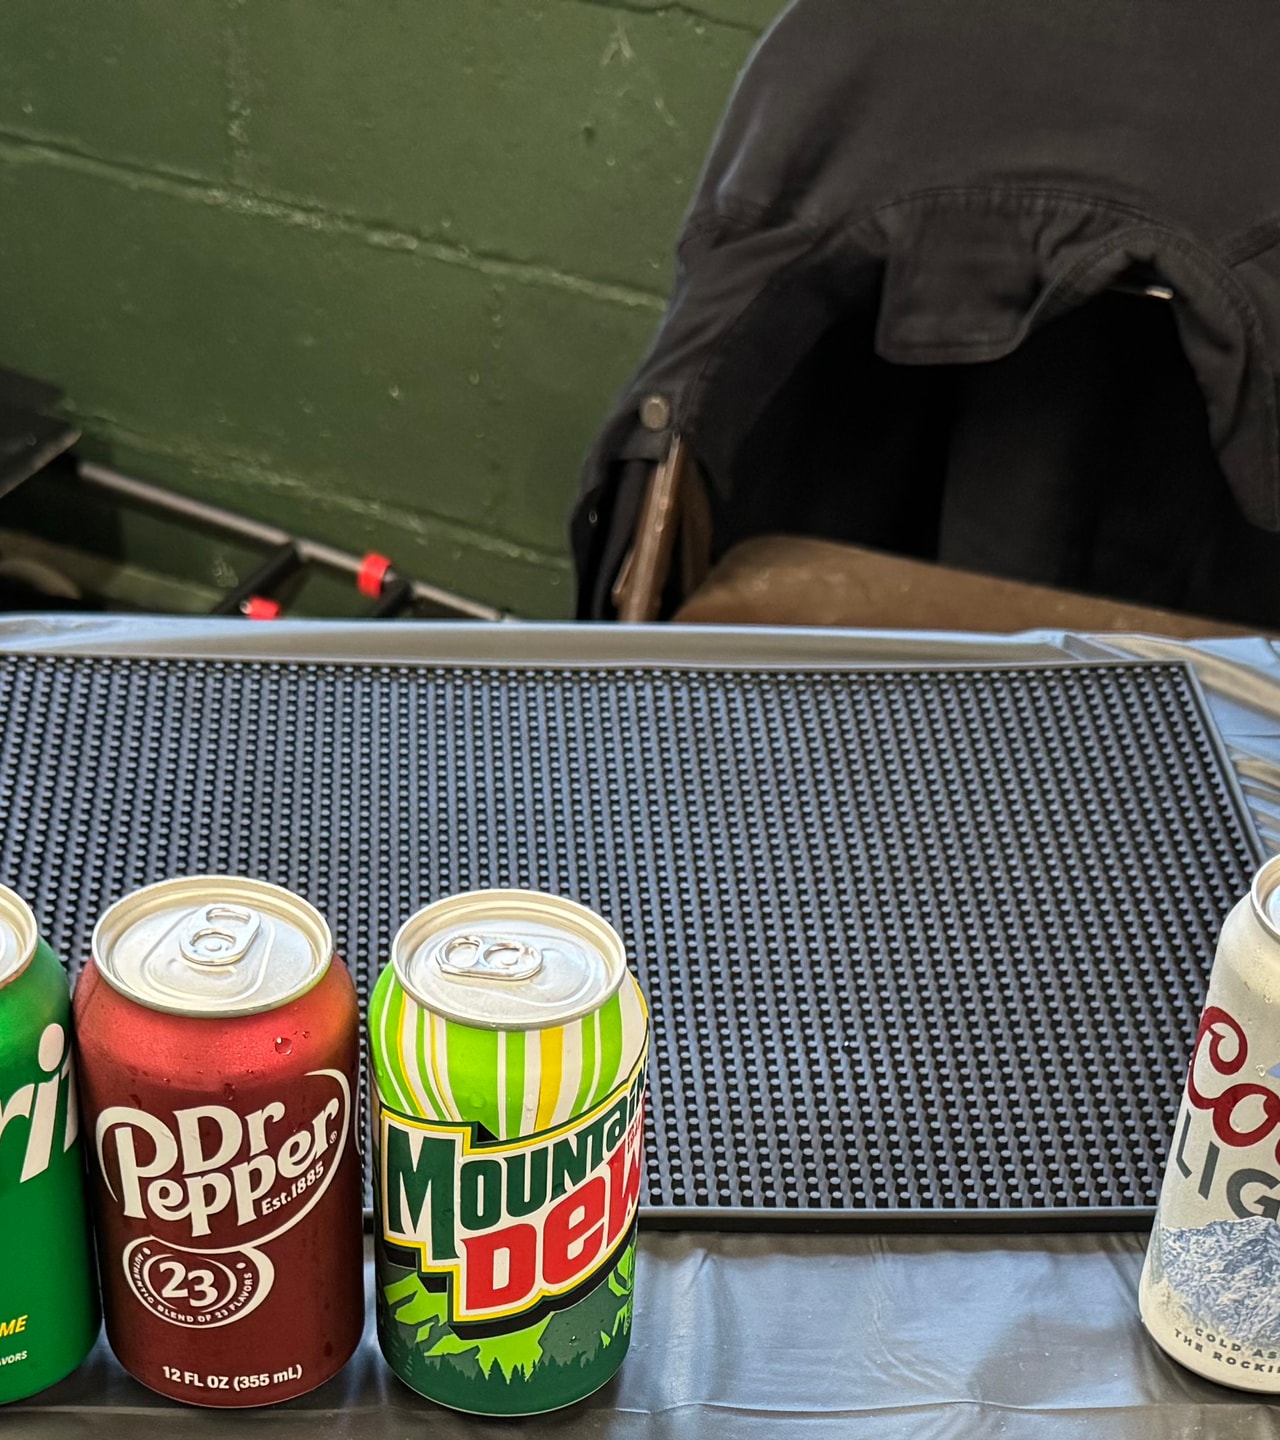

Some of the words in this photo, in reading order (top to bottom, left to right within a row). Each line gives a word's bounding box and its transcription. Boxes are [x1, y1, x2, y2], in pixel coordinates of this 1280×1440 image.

[173, 1101, 286, 1176] Dr
[95, 1098, 340, 1238] Pepper
[132, 1252, 155, 1305] AUTHENTIC
[156, 1304, 195, 1323] BLEND
[197, 1315, 212, 1323] OF
[228, 1272, 254, 1311] FLAVORS
[158, 1261, 219, 1308] 23
[1174, 1328, 1204, 1353] THE
[1194, 1327, 1242, 1352] COLD
[1252, 1348, 1278, 1360] AS
[162, 1365, 182, 1383] 12
[184, 1370, 205, 1387] FL
[206, 1375, 230, 1389] OZ
[233, 1373, 270, 1392] (355
[272, 1363, 303, 1384] mL)
